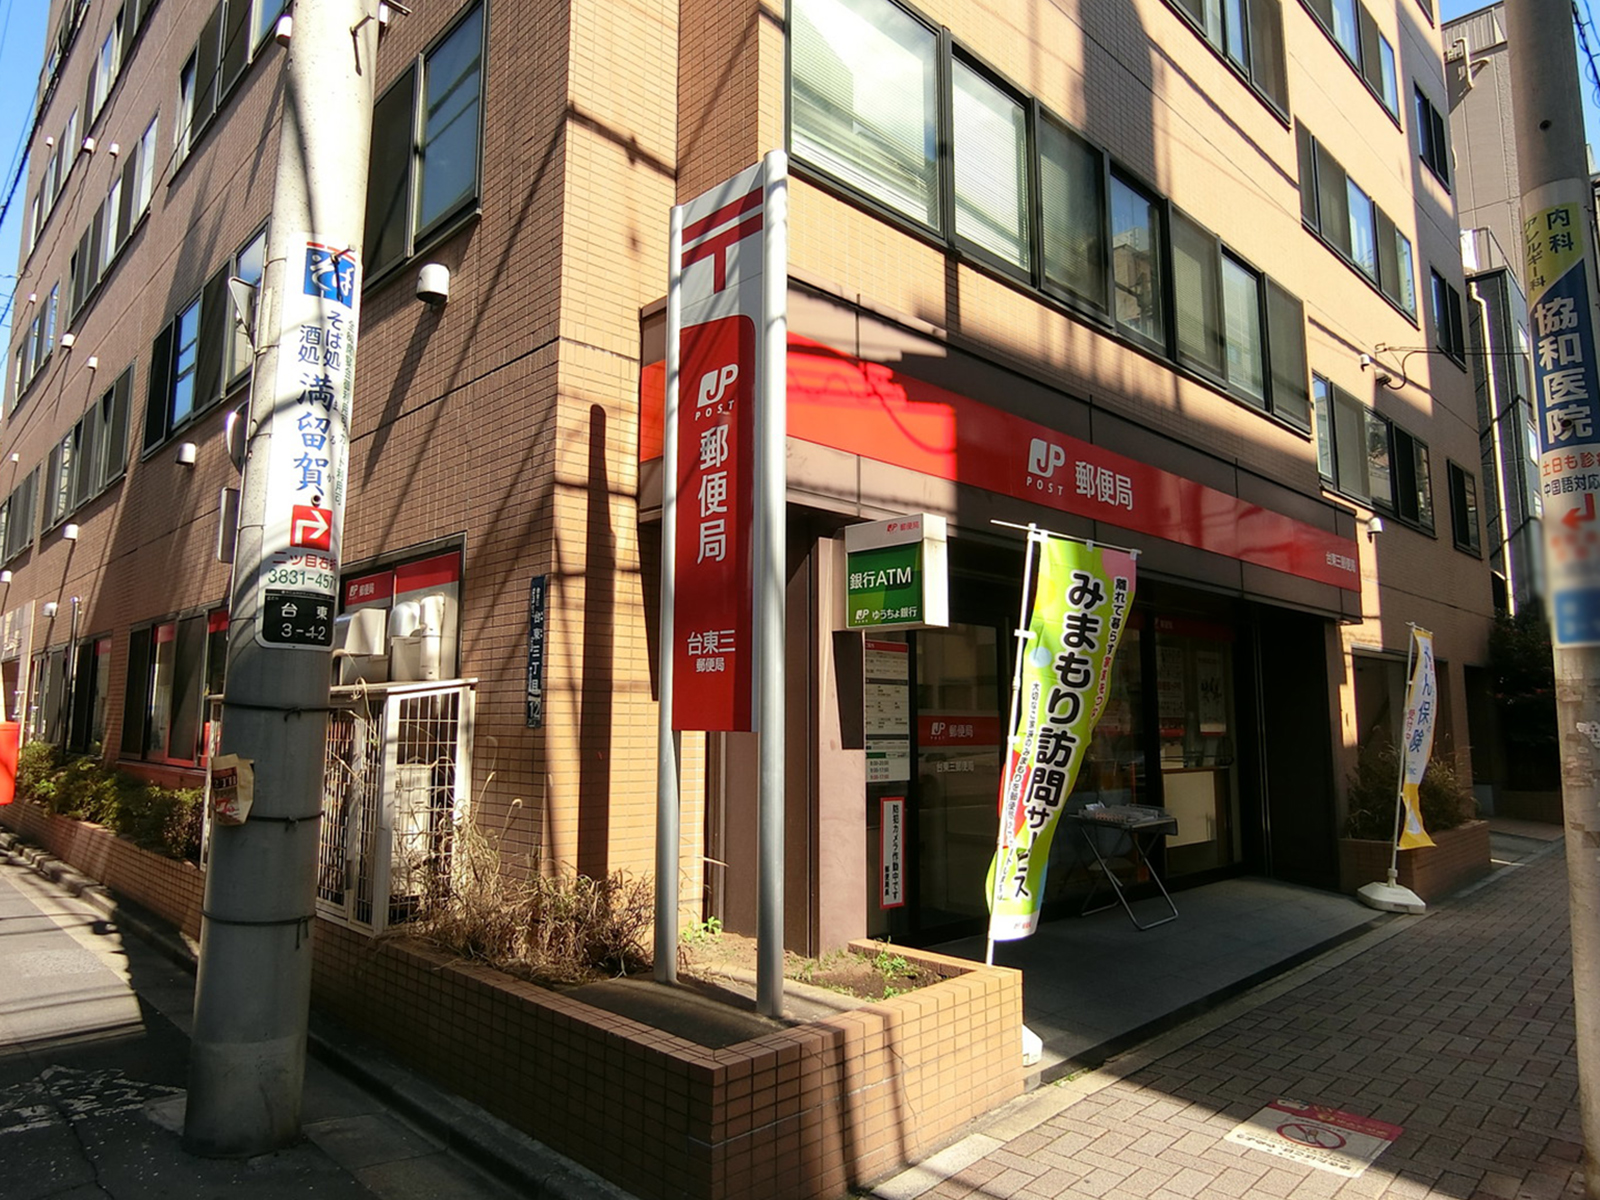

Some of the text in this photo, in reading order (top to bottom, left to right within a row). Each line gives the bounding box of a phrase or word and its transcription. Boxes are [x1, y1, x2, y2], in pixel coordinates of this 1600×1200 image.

[1547, 208, 1574, 254] 内科
[1524, 216, 1546, 292] アレルギー科
[298, 325, 322, 366] 酒処
[323, 310, 344, 371] そば処
[697, 363, 739, 408] JP
[1535, 296, 1594, 444] 協和医院
[695, 399, 735, 421] POST
[293, 373, 335, 496] 満留賀
[1028, 438, 1133, 511] JP 郵便局
[1543, 452, 1600, 477] 土日も診
[697, 424, 729, 564] 郵便局
[1026, 476, 1064, 496] POST
[1544, 473, 1600, 497] 中国語対応
[900, 520, 920, 531] 郵便局
[849, 566, 912, 590] 銀行ATM
[872, 606, 917, 621] ゆうちょ銀行
[687, 629, 736, 656] 台東三
[695, 657, 725, 673] 郵便局
[1409, 645, 1432, 753] がん保険
[949, 724, 974, 738] 郵便局
[1013, 573, 1105, 898] みまもり訪問サービス
[1405, 708, 1416, 740] 受付中
